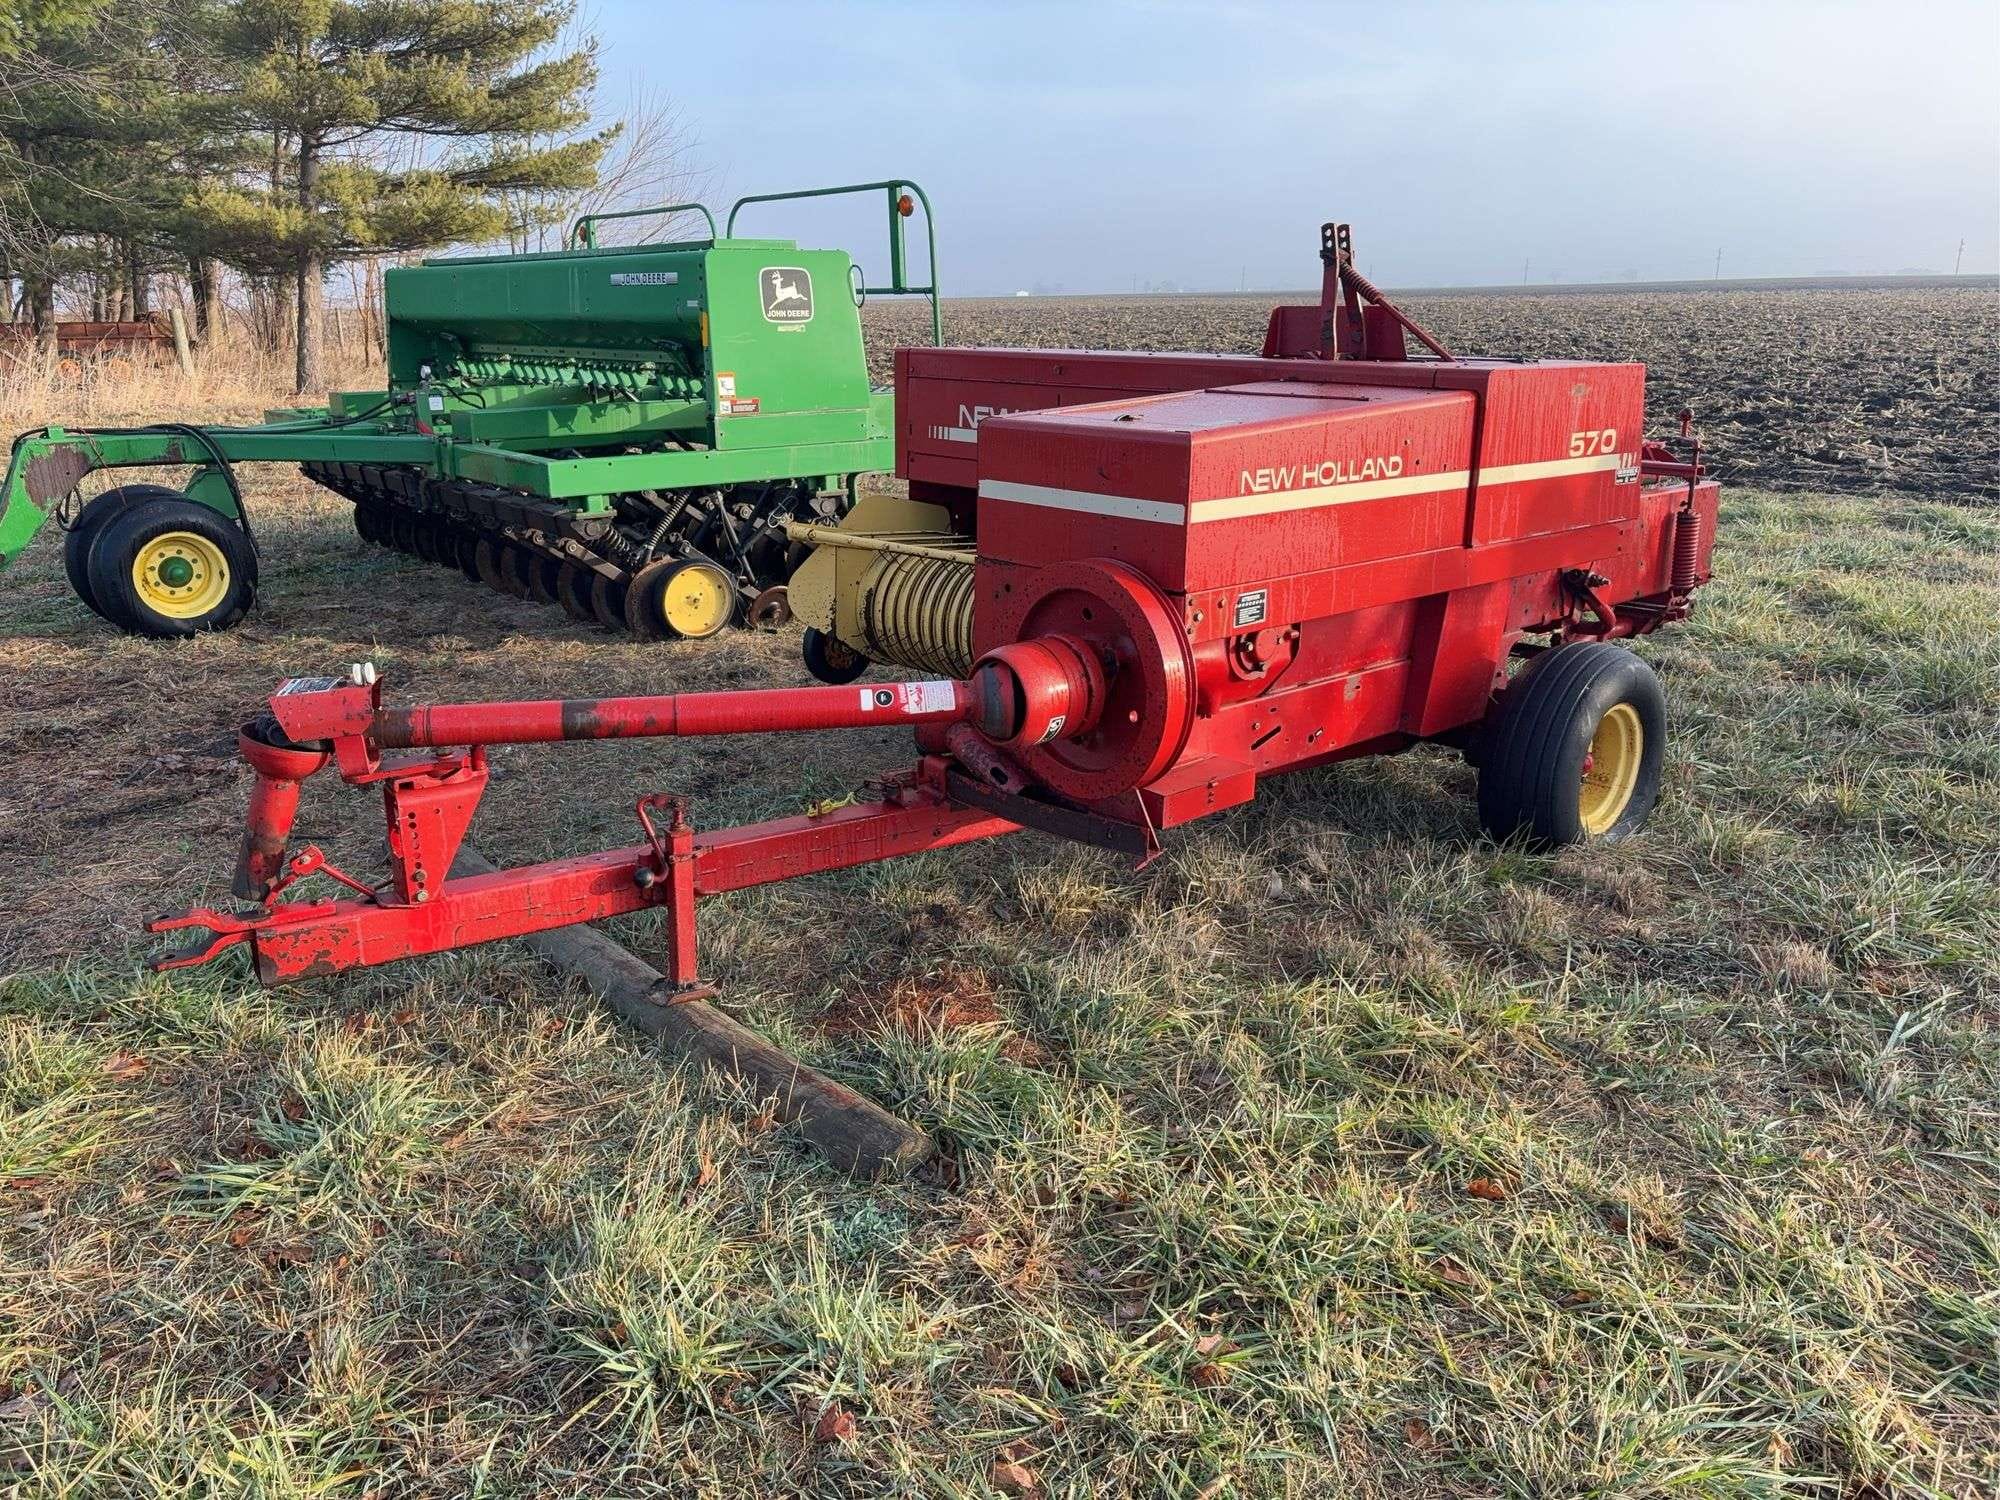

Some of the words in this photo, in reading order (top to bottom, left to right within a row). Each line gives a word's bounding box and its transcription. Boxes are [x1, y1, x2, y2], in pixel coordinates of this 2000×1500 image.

[621, 273, 641, 286] JOHN
[642, 272, 666, 285] DEERE
[767, 310, 786, 318] JOHN
[787, 309, 810, 318] DEERE
[1569, 428, 1617, 457] 570
[1240, 466, 1297, 494] NEW
[1302, 455, 1403, 487] HOLLAND
